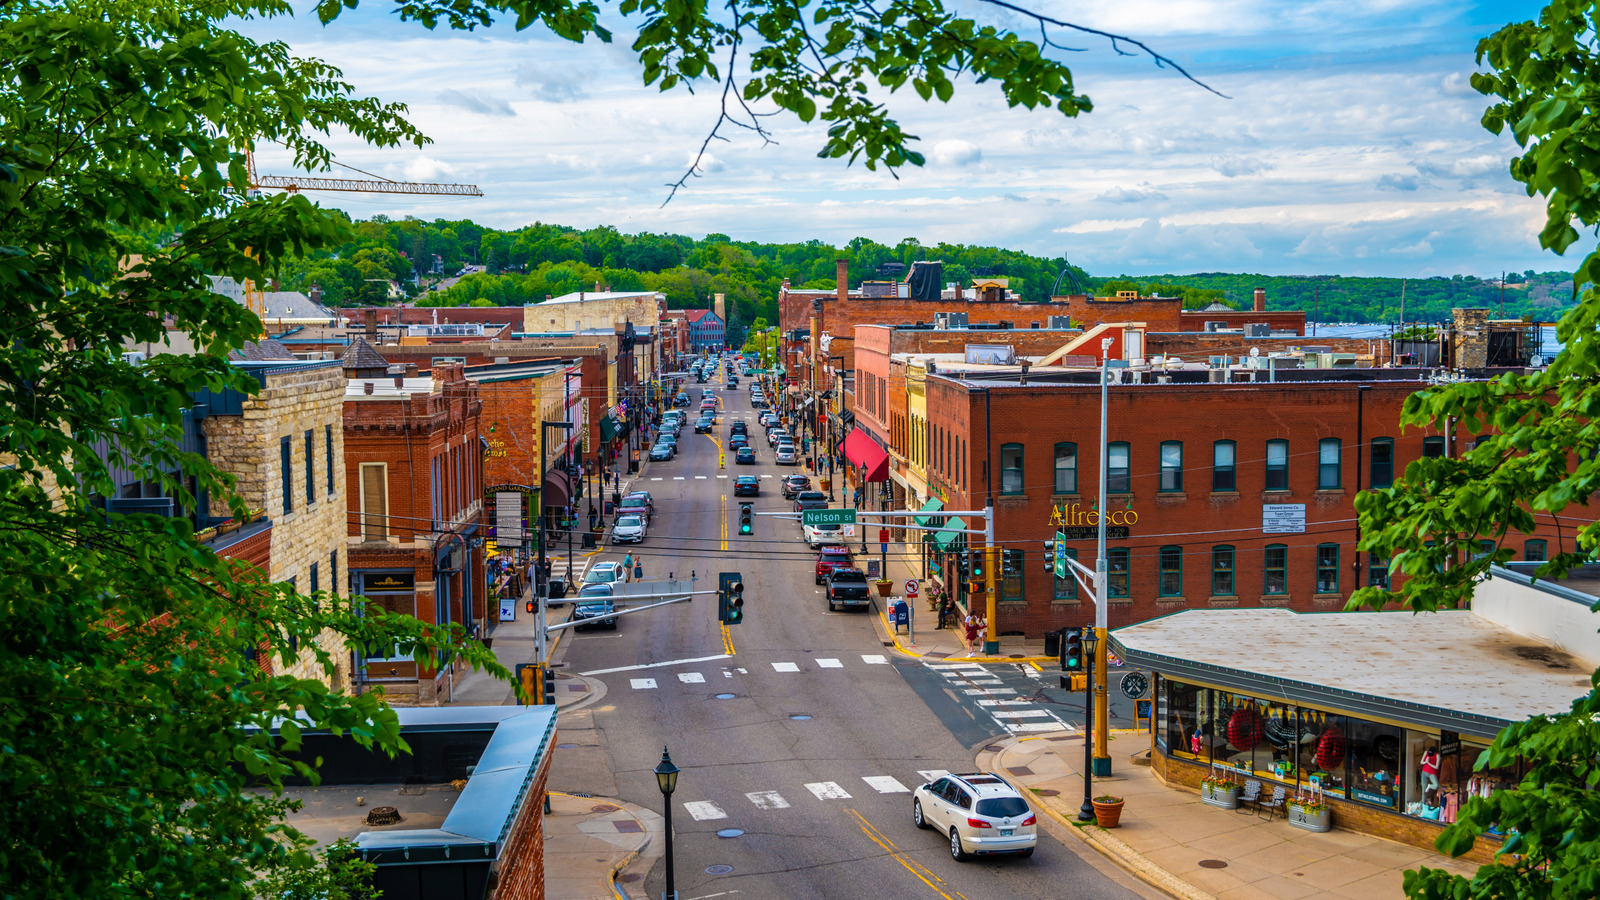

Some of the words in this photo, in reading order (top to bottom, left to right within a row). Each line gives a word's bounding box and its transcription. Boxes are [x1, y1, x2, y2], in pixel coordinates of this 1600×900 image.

[485, 485, 507, 494] GRAND
[508, 485, 532, 494] GARAGE
[807, 513, 840, 522] Nelson
[1047, 503, 1139, 526] Alfresco
